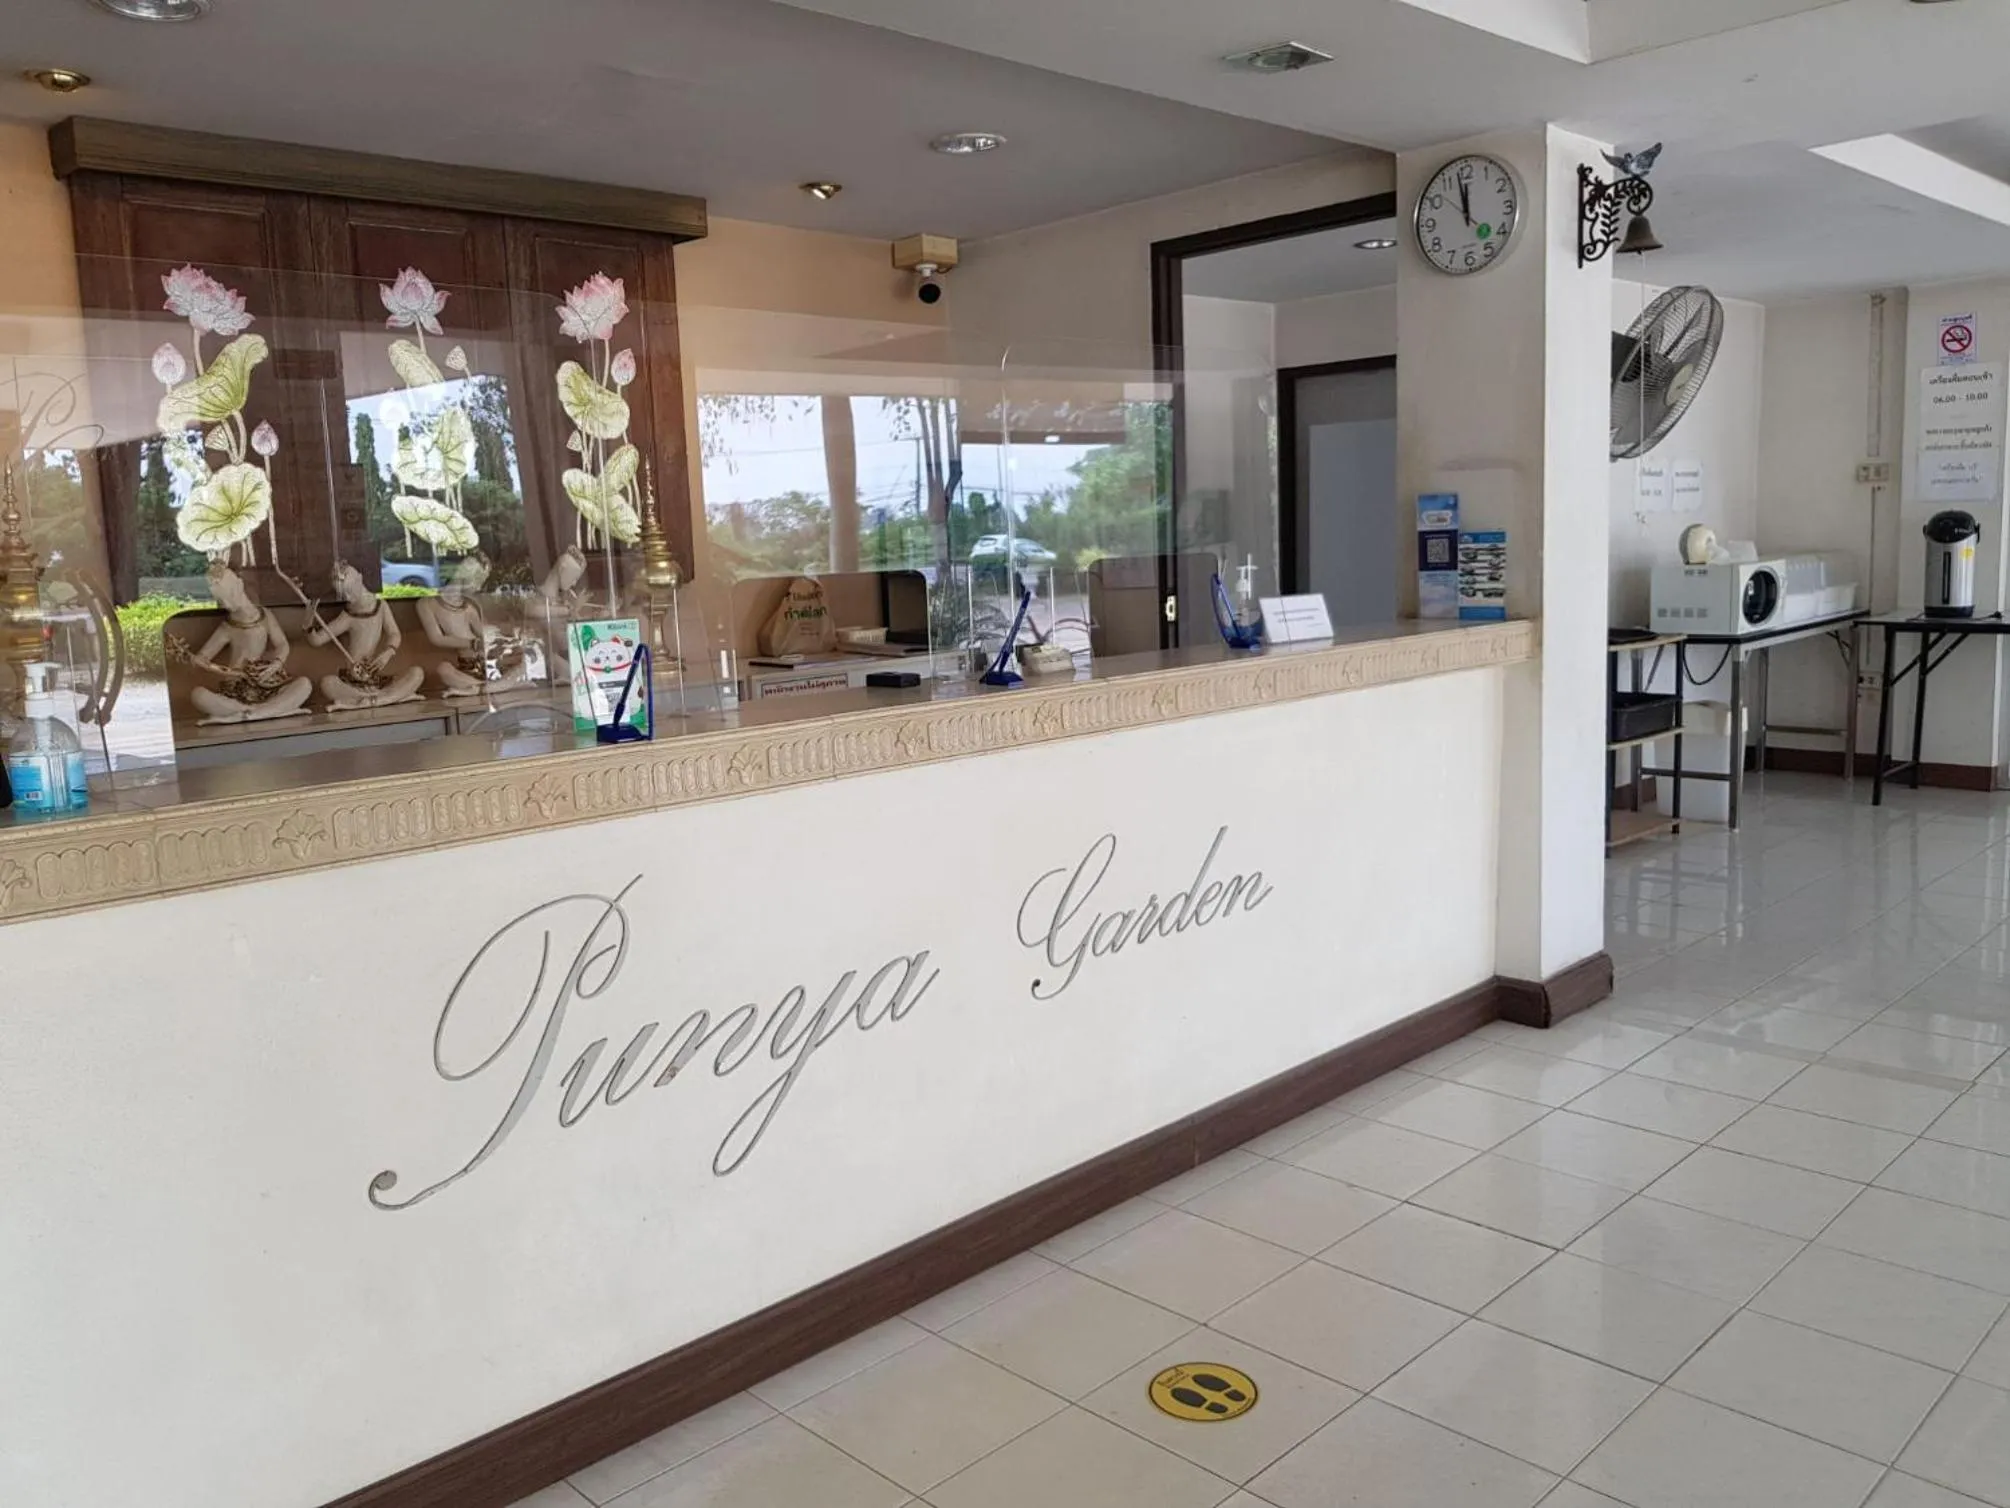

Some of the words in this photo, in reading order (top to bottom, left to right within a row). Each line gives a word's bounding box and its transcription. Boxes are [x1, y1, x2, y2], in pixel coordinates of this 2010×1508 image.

[1459, 164, 1474, 180] 12
[1442, 176, 1453, 192] 11
[1495, 178, 1508, 194] 2
[1502, 199, 1514, 216] 3
[1424, 217, 1436, 233] 9
[1496, 221, 1508, 236] 4
[1431, 236, 1442, 253] 8
[1483, 241, 1495, 258] 5
[1447, 249, 1456, 265] 7
[1464, 250, 1476, 267] 6
[368, 872, 941, 1212] Punya
[1016, 825, 1275, 1001] Garden
